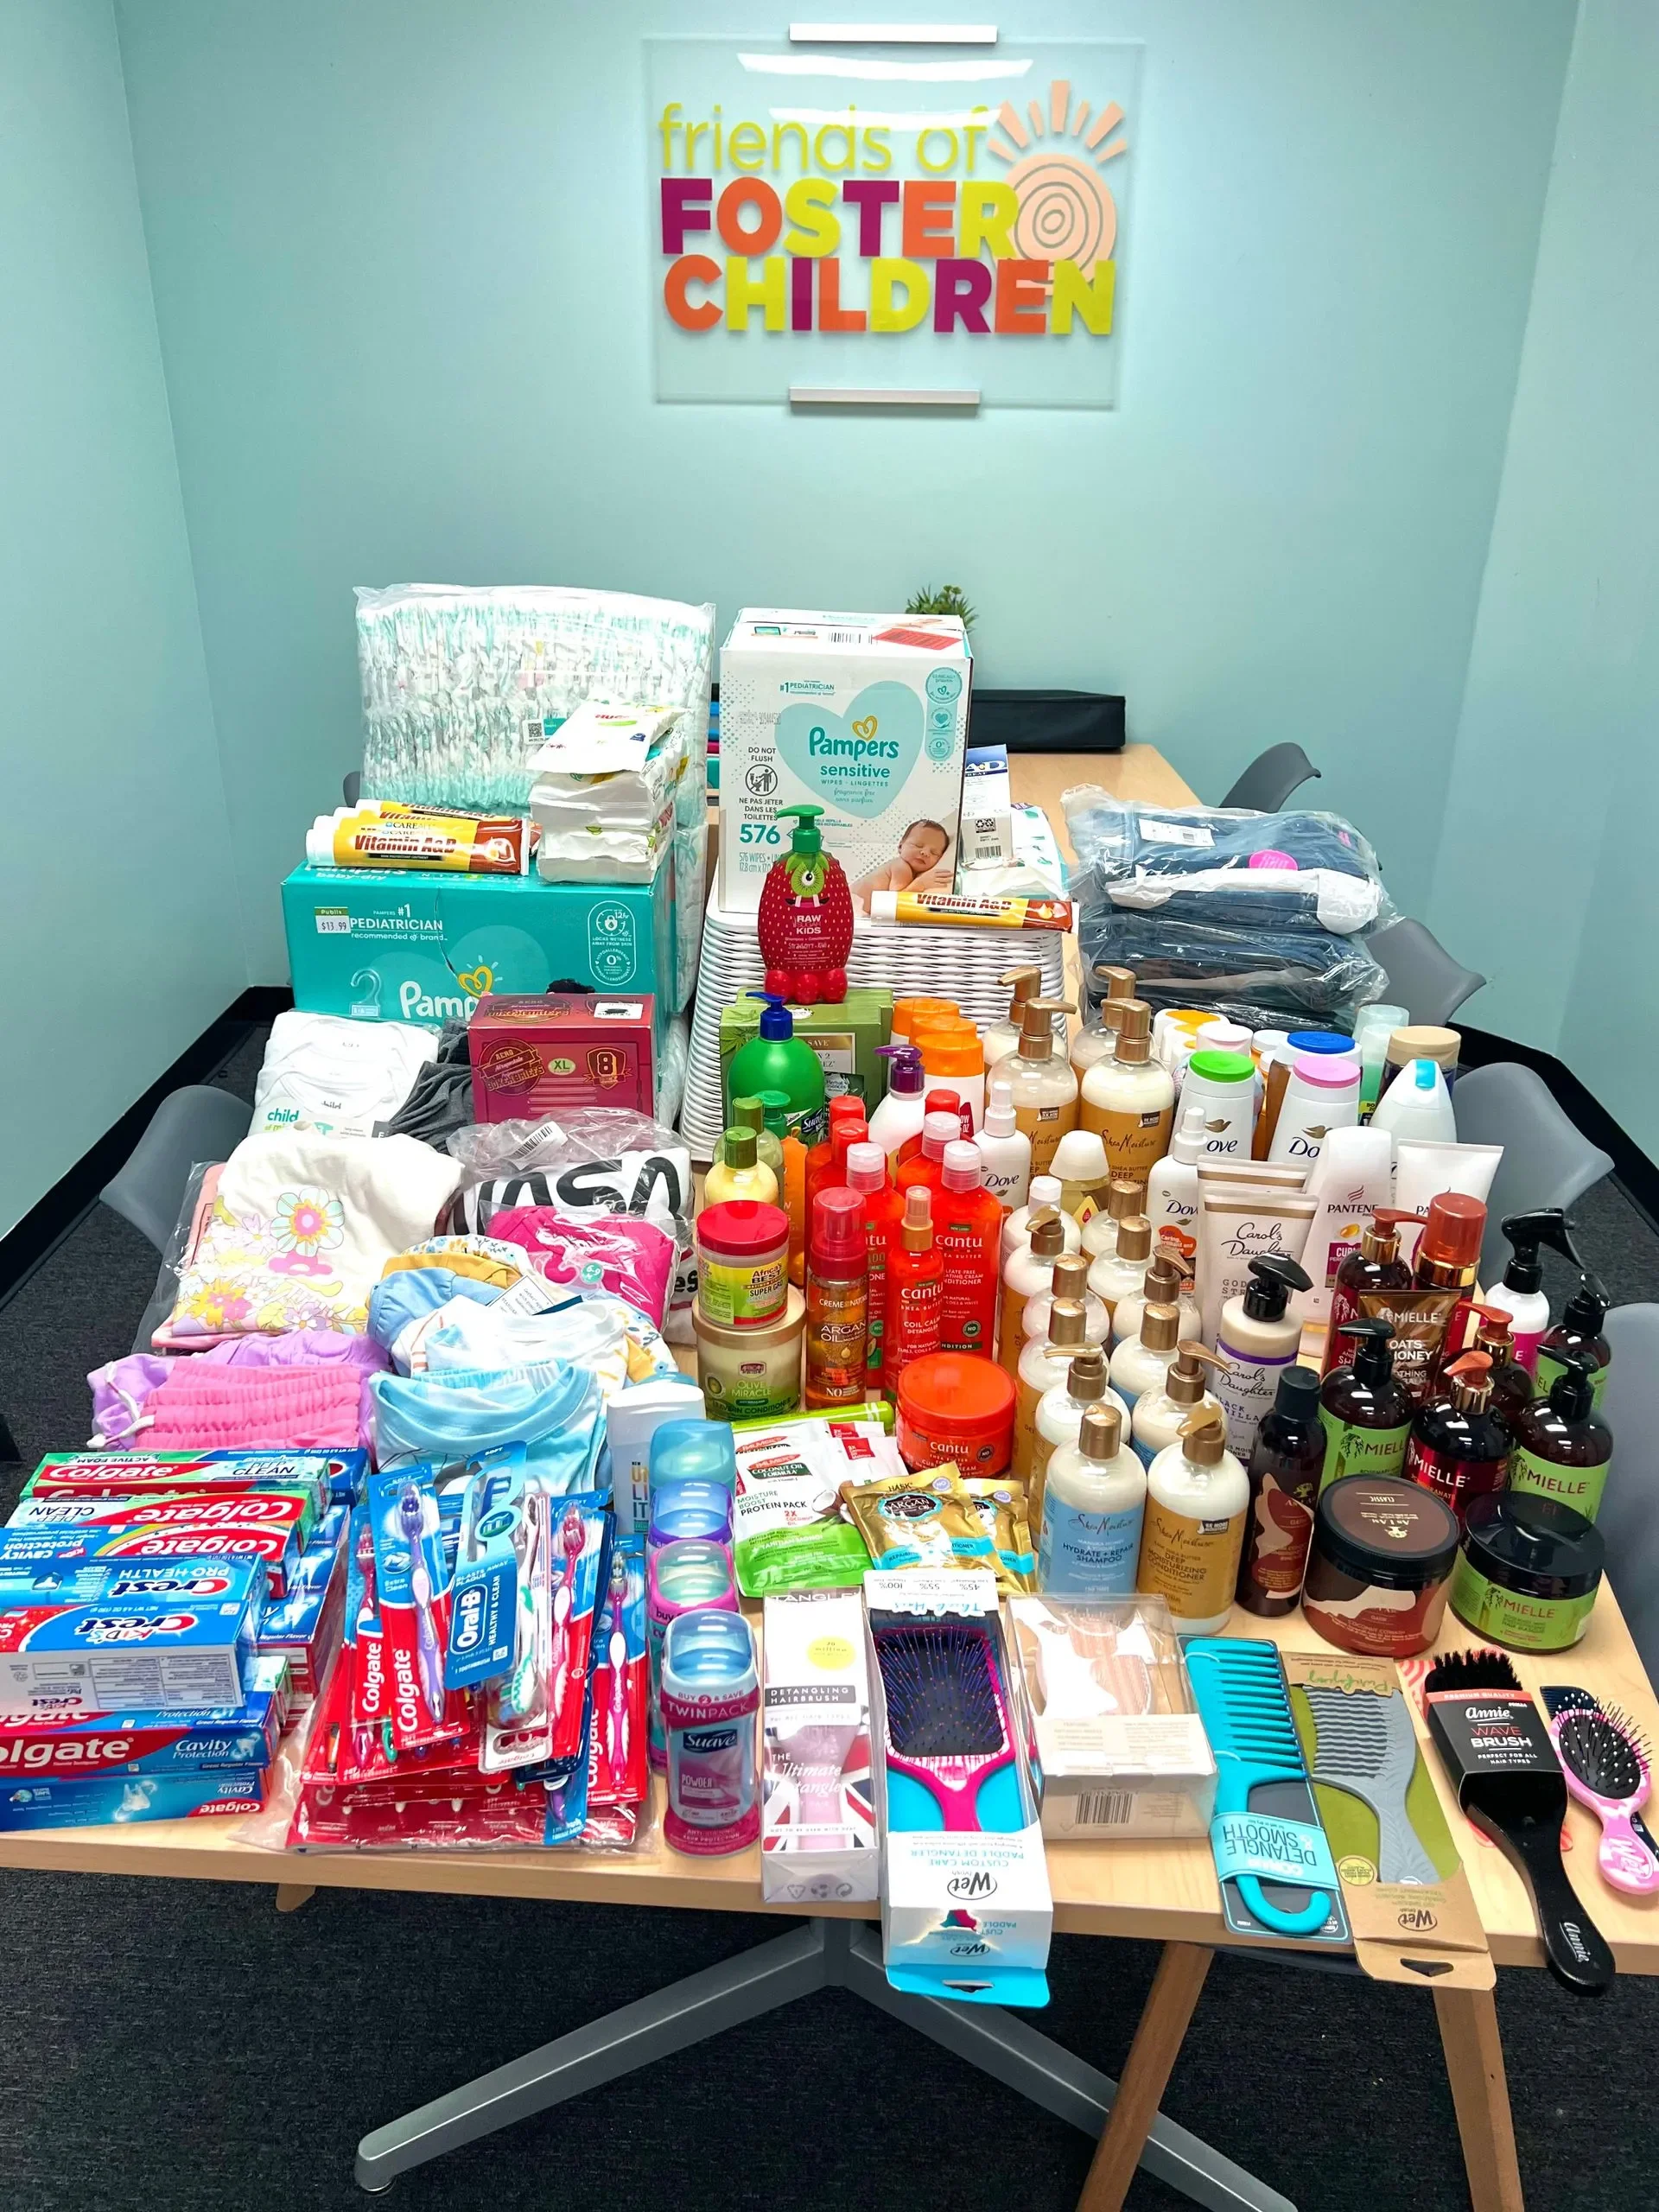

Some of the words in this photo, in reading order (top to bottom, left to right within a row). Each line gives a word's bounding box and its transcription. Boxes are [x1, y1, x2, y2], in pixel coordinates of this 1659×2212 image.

[658, 102, 893, 172] friends
[916, 105, 991, 172] of
[661, 177, 1020, 258] FOSTER
[664, 253, 1116, 336] CHILDREN
[790, 682, 835, 691] PEDIATRICIAN
[809, 726, 899, 761] Pampers
[820, 762, 890, 779] sensitive
[744, 813, 779, 822] TOILETTES
[740, 824, 781, 844] 576
[354, 834, 418, 852] Vitamin
[421, 836, 458, 854] A&D
[749, 852, 767, 862] WIPES
[917, 893, 976, 908] Vitamin
[978, 899, 1012, 910] A&D
[397, 903, 411, 918] #1
[321, 921, 346, 931] $13.99
[350, 918, 443, 931] PEDIATRICIAN
[400, 981, 477, 1020] Pamp
[496, 1049, 514, 1060] AERO
[554, 1059, 571, 1071] XL
[597, 1052, 617, 1077] 8
[268, 1107, 300, 1122] child
[1206, 1138, 1238, 1154] ove
[985, 1173, 1020, 1187] Dove
[1111, 1171, 1135, 1179] DEEP
[1236, 1221, 1283, 1242] Carol's
[936, 1234, 982, 1249] cantu
[752, 1269, 783, 1285] BEST
[749, 1287, 772, 1298] SUPER
[901, 1281, 944, 1300] cantu
[819, 1298, 844, 1309] CREME
[925, 1315, 942, 1327] CALM
[1393, 1313, 1439, 1324] MIELLE
[821, 1322, 866, 1335] ARGAN
[907, 1324, 939, 1335] DETANGLER
[821, 1333, 843, 1343] OIL
[1389, 1339, 1424, 1349] OATS
[736, 1381, 767, 1390] OLIVE
[1217, 1369, 1276, 1397] Daughter
[731, 1387, 772, 1397] MIRACLE
[826, 1388, 843, 1398] NO
[485, 1446, 504, 1456] SOFT
[930, 1441, 969, 1454] cantu
[49, 1465, 175, 1480] Colgate
[232, 1465, 296, 1477] CLEAN
[752, 1464, 789, 1475] COCONUT
[763, 1469, 798, 1478] FORMULA
[1414, 1454, 1466, 1488] MIELLE
[888, 1482, 912, 1493] HASK
[1527, 1468, 1586, 1495] MIELLE
[737, 1490, 779, 1504] MOISTURE
[739, 1497, 766, 1510] BOOST
[890, 1497, 930, 1511] ARGAN
[1370, 1495, 1395, 1503] CLASSIC
[29, 1506, 95, 1517] CLEAN
[131, 1498, 293, 1522] Colgate
[741, 1501, 782, 1516] PROTEIN
[783, 1500, 808, 1510] PACK
[37, 1515, 76, 1523] DEEP
[3, 1540, 84, 1550] protection
[141, 1534, 278, 1556] Colgate
[1063, 1542, 1100, 1558] HYDRATE
[1110, 1543, 1134, 1556] REPAIR
[0, 1549, 54, 1560] cavity
[1077, 1555, 1123, 1564] SHAMPOO
[1147, 1548, 1208, 1574] MOISTURIZING
[1165, 1552, 1186, 1565] DEEP
[456, 1567, 486, 1580] BLASTS
[486, 1560, 511, 1573] AWAY
[1147, 1556, 1206, 1581] CONDITIONER
[456, 1572, 487, 1587] PLAQUE
[879, 1581, 903, 1591] 100%
[919, 1582, 941, 1591] 55%
[107, 1578, 230, 1598] Crest
[385, 1583, 409, 1593] Clean
[491, 1574, 501, 1603] CLEAN
[491, 1602, 499, 1611] &
[1503, 1599, 1556, 1618] MIELLE
[455, 1588, 482, 1648] Oral-B
[656, 1608, 675, 1623] buy
[74, 1614, 199, 1636] Crest
[487, 1610, 499, 1646] HEALTHY
[86, 1628, 154, 1643] KID'S
[362, 1640, 386, 1713] Colgate
[394, 1647, 422, 1734] Colgate
[613, 1678, 624, 1713] Colgate
[677, 1692, 696, 1702] BUY
[702, 1694, 710, 1705] 2
[721, 1690, 745, 1701] SAVE
[771, 1688, 849, 1697] DETANGLING
[1444, 1691, 1481, 1700] PREMIUM
[1481, 1691, 1516, 1700] QUALITY
[32, 1696, 83, 1707] Crest
[771, 1694, 841, 1705] HAIRBRUSH
[156, 1707, 212, 1719] Protection
[667, 1700, 749, 1720] TWINPACK
[1471, 1726, 1522, 1737] WAVE
[175, 1738, 233, 1753] Cavity
[587, 1706, 607, 1788] Colgate
[686, 1732, 737, 1751] Suave
[1470, 1736, 1534, 1748] BRUSH
[0, 1737, 130, 1770] olgate
[173, 1750, 230, 1760] Protection
[772, 1752, 791, 1762] THE
[681, 1773, 713, 1789] POWDER
[217, 1785, 254, 1796] Cavity
[200, 1802, 262, 1815] Colgate
[1222, 1823, 1300, 1849] SMOOTH
[911, 1849, 978, 1858] DETANGLER
[982, 1851, 1025, 1860] PADDLE
[1227, 1838, 1318, 1867] DETANGLE
[1607, 1836, 1645, 1883] Wet
[929, 1858, 957, 1866] CARE
[962, 1859, 1010, 1867] CUSTOM
[951, 1872, 991, 1896] Wet
[1402, 1909, 1434, 1928] Wet
[954, 1942, 986, 1955] Wet
